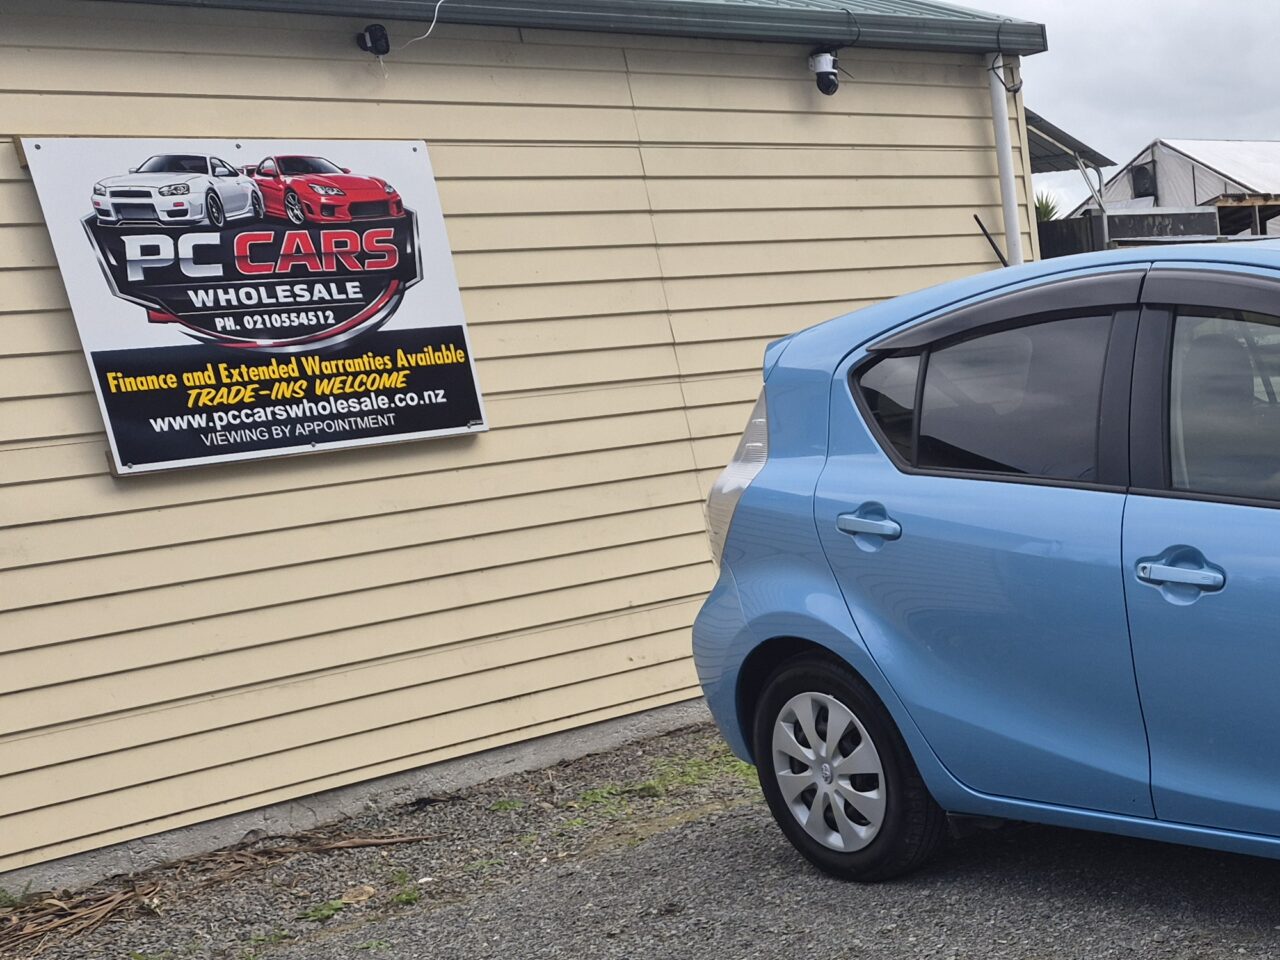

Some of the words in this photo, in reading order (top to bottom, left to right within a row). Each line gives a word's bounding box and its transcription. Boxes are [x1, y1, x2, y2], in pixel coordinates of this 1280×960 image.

[120, 232, 223, 281] PC
[234, 228, 399, 275] CARS
[187, 281, 363, 308] WHOLESALE
[214, 316, 240, 332] PH.
[243, 310, 336, 330] 0210554512
[106, 371, 178, 393] Finance
[182, 363, 216, 387] and
[218, 356, 300, 384] Extended
[301, 352, 392, 376] Warranties
[396, 343, 465, 368] Available
[186, 379, 308, 409] TRADE-INS
[315, 370, 411, 396] WELCOME
[149, 389, 447, 432] www.pccarswholesale.co.nz
[200, 427, 269, 446] VIEWING
[272, 424, 291, 439] BY
[295, 413, 396, 436] APPOINTMENT
